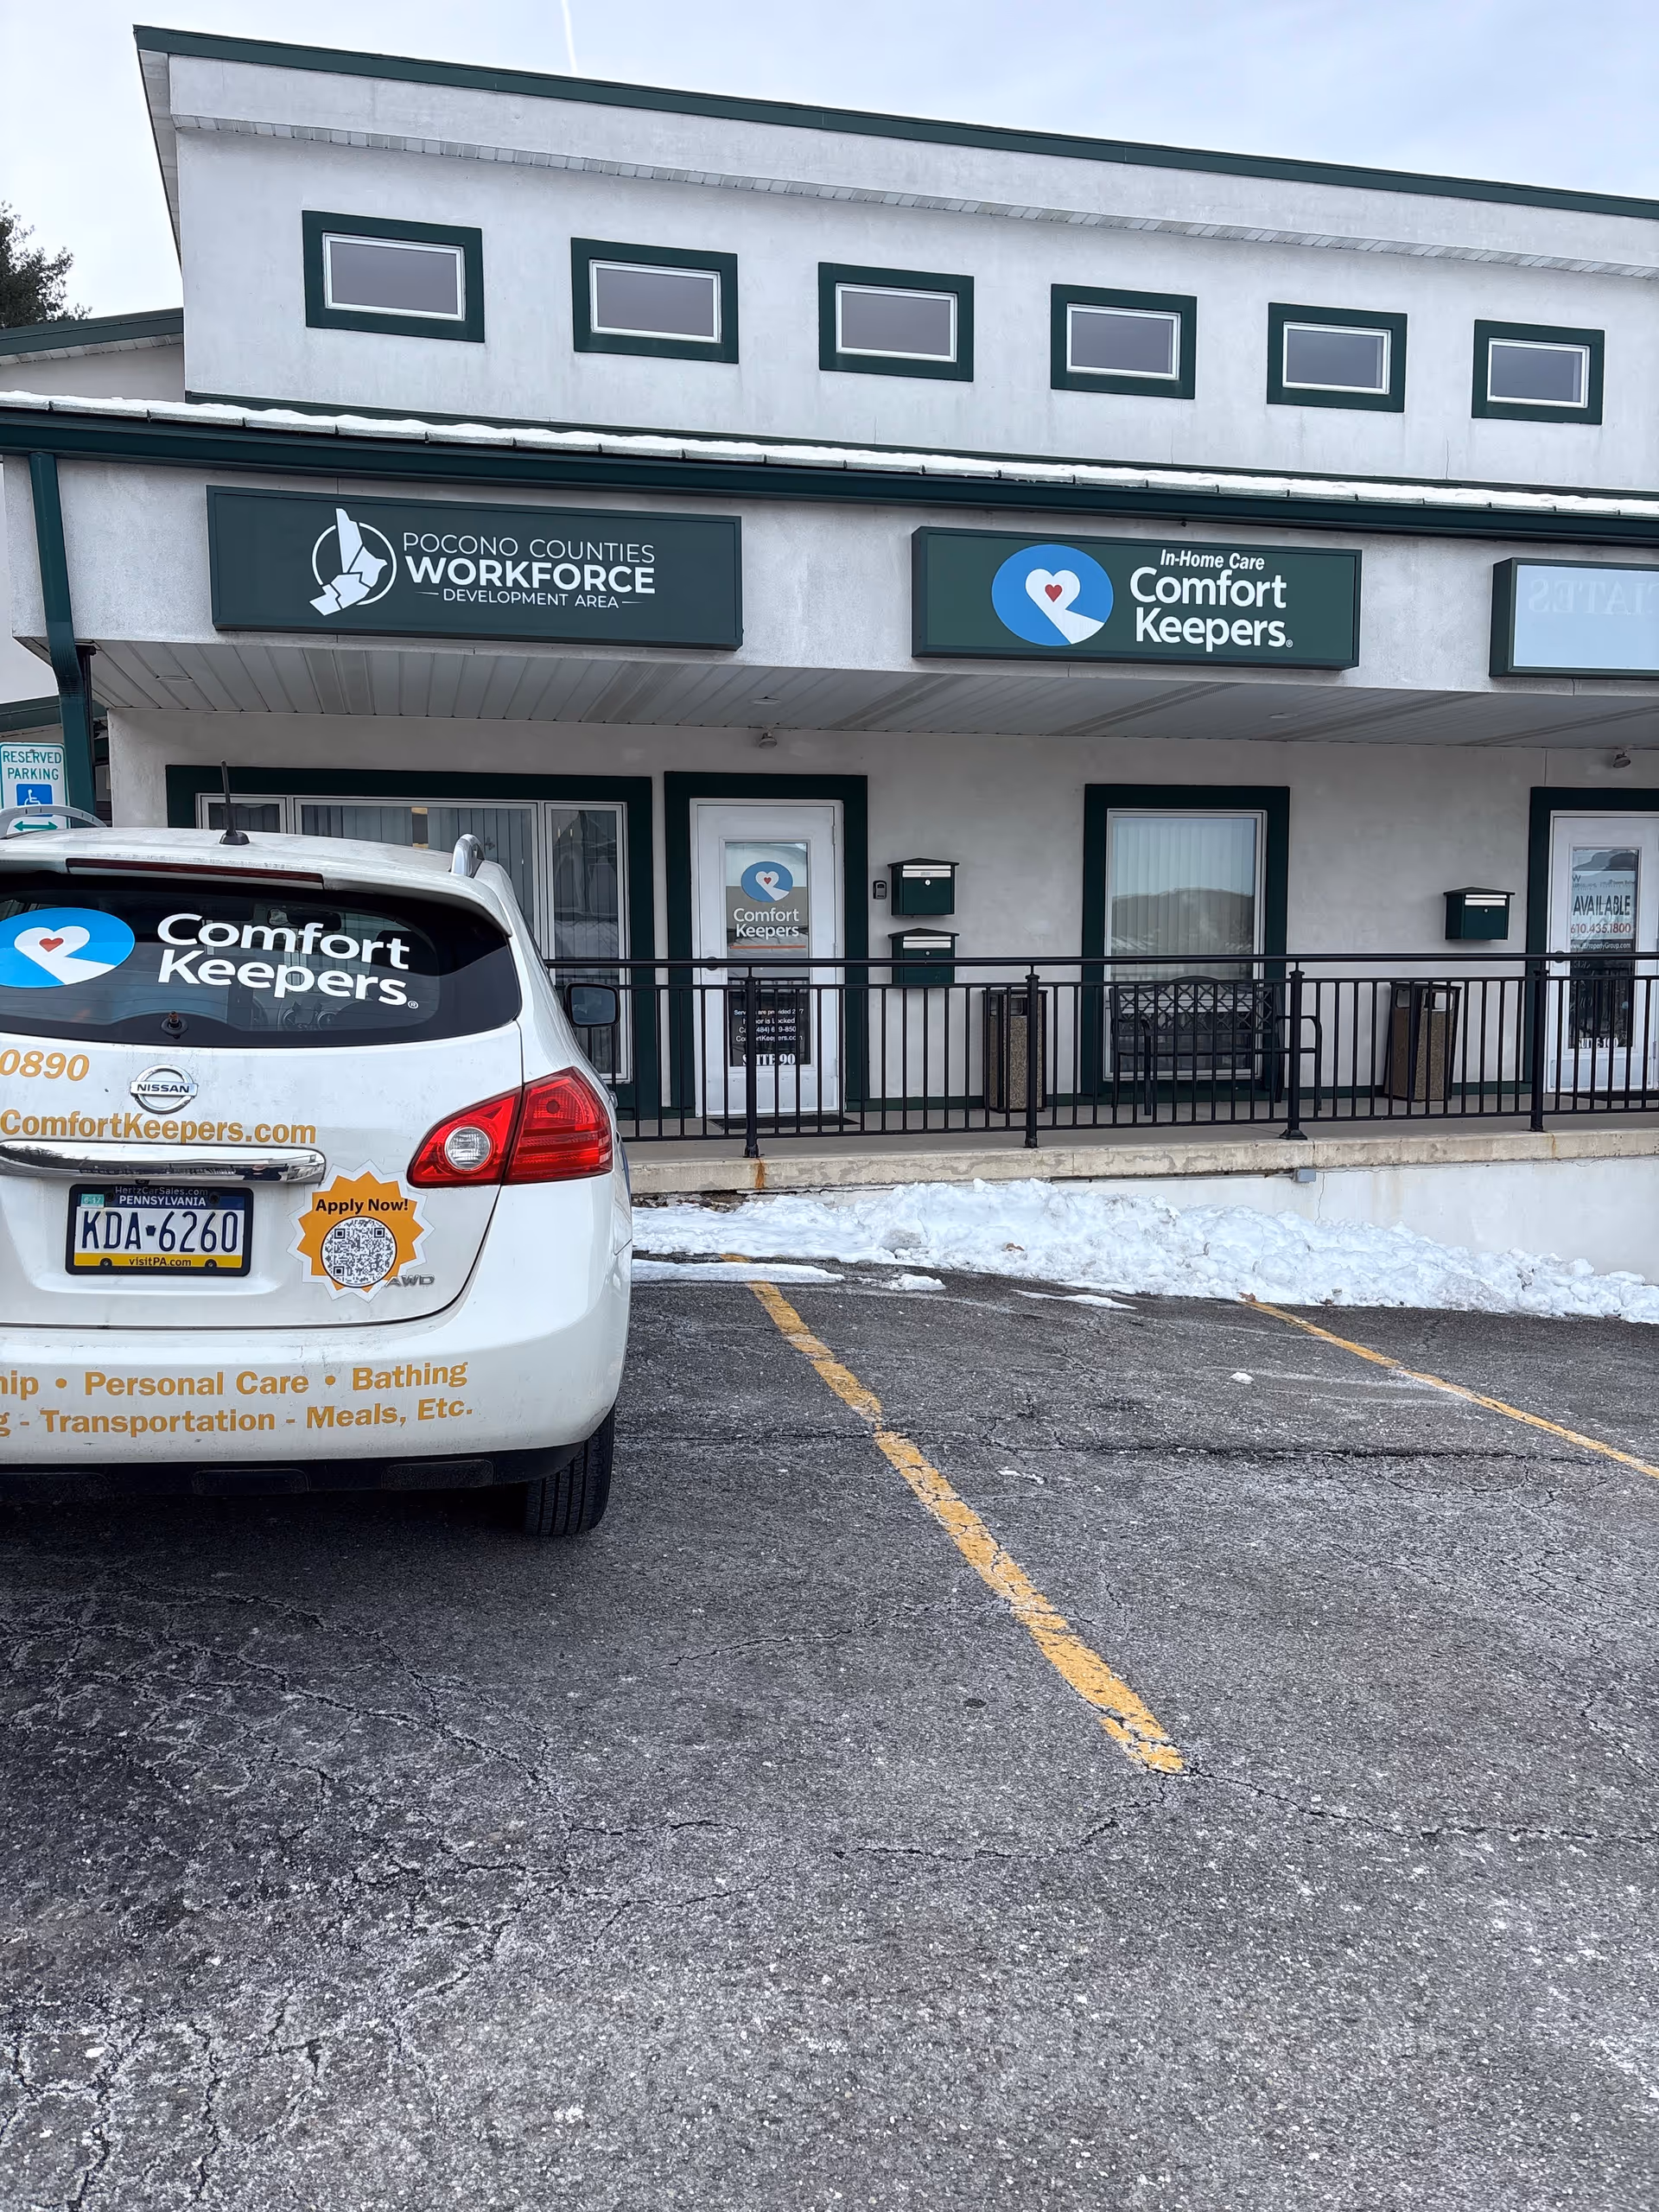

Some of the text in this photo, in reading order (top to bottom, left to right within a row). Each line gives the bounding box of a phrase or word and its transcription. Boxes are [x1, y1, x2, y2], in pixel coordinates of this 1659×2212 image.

[404, 532, 655, 563] POCONO COUNTIES
[1160, 549, 1265, 570] In-Home Care
[405, 556, 656, 594] WORKFORCE
[1130, 566, 1287, 608] Comfort
[443, 588, 619, 608] DEVELOPMENT AREA
[3, 751, 61, 763] RESERVED
[8, 767, 59, 780] PARKING
[1573, 895, 1631, 916] AVAILABLE
[734, 907, 799, 922] Comfort
[736, 924, 799, 939] Keepers
[1570, 923, 1631, 933] 610.435.1800
[157, 913, 410, 970] Comfort
[0, 1049, 90, 1081] 0890
[779, 1053, 796, 1065] 90
[137, 1084, 190, 1094] NISSAN
[0, 1109, 316, 1144] ComfortKeepers.com
[115, 1186, 208, 1196] HertzCarSales.com
[118, 1196, 207, 1206] PENNSYLVANIA
[315, 1198, 409, 1215] Apply Now!
[129, 1256, 192, 1267] visitPA.com
[385, 1274, 435, 1287] AWD
[85, 1371, 224, 1396] Personal
[236, 1370, 309, 1395] Care
[353, 1362, 468, 1391] Bathing
[40, 1408, 275, 1438] Transportation
[307, 1402, 406, 1429] Meals,
[418, 1397, 473, 1421] Etc.
